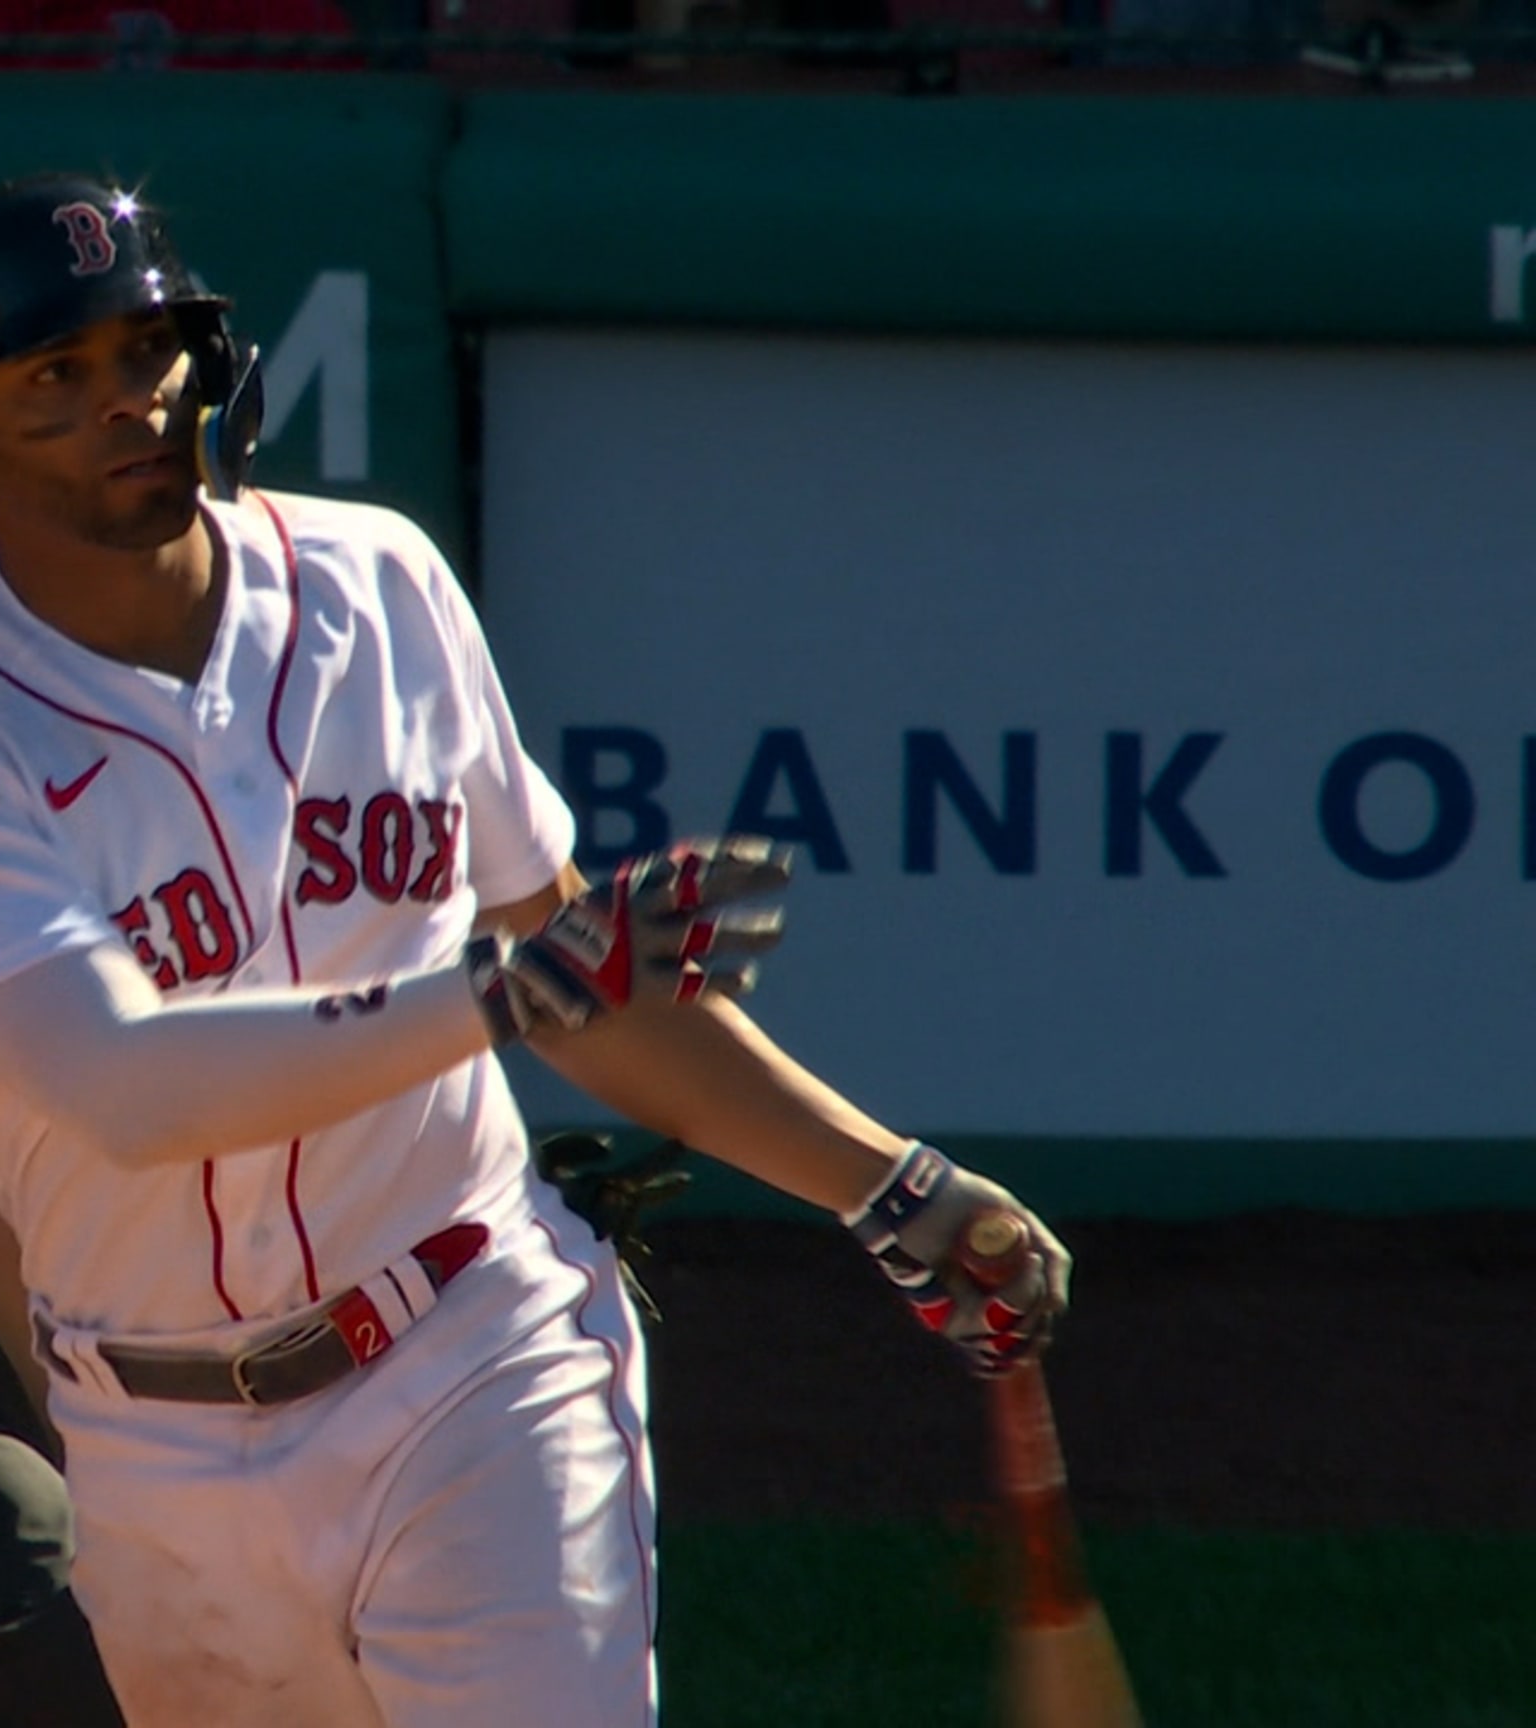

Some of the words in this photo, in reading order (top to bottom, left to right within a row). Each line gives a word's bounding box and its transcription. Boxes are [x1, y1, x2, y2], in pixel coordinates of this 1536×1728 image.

[52, 201, 117, 278] B
[561, 725, 1228, 878] BANK
[1316, 731, 1536, 881] O
[108, 867, 239, 990] ED
[295, 791, 463, 906] SOX
[354, 1321, 384, 1358] 2
